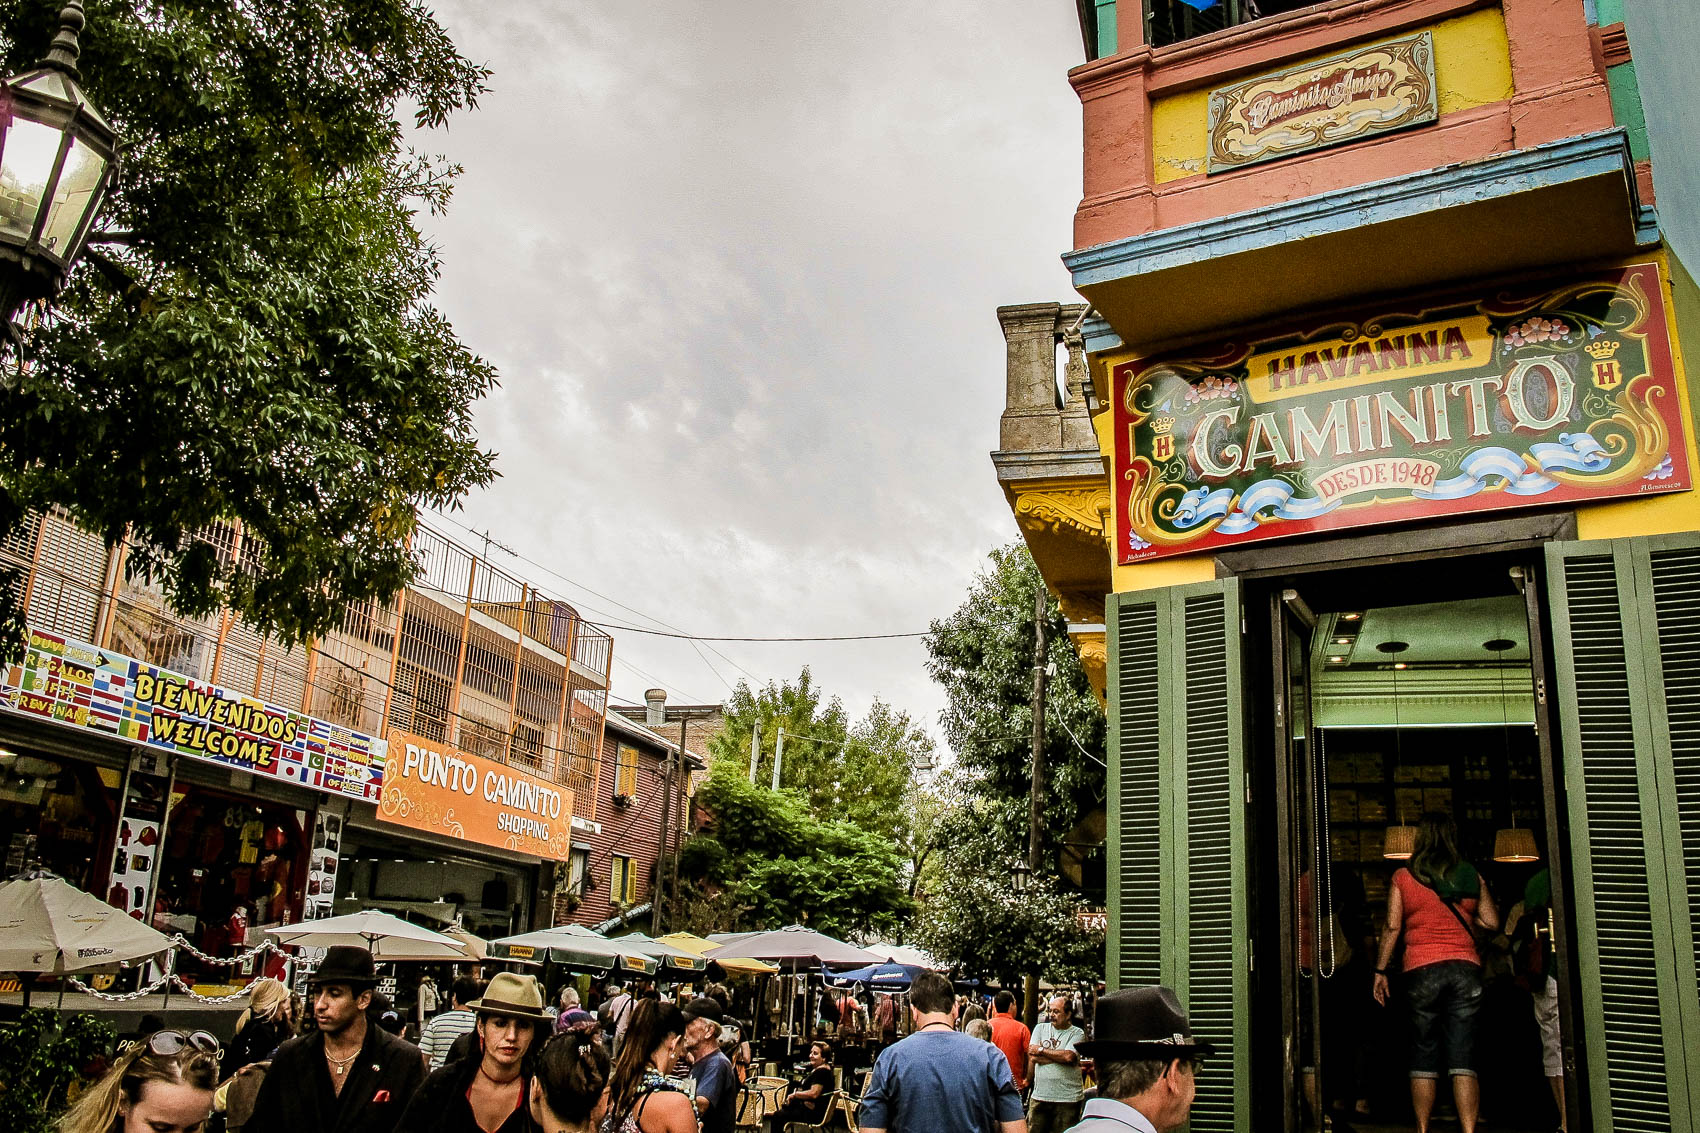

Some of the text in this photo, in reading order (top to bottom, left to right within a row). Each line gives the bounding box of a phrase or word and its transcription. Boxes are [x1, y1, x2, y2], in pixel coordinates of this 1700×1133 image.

[1248, 68, 1392, 128] Caminito Amigo
[1268, 326, 1473, 391] HAVANNA
[1596, 363, 1616, 385] H
[1191, 355, 1576, 478] CAMINITO
[1156, 436, 1170, 457] H
[1317, 462, 1435, 498] DESDE 1948
[27, 654, 94, 682] REGALOS
[32, 678, 77, 699] GIFTS
[9, 692, 98, 726] PREVENANCE
[135, 674, 297, 743] BIENVENIDOS
[152, 714, 274, 767] WELCOME
[402, 744, 561, 819] PUNTO CAMINITO
[498, 812, 549, 841] SHOPPING
